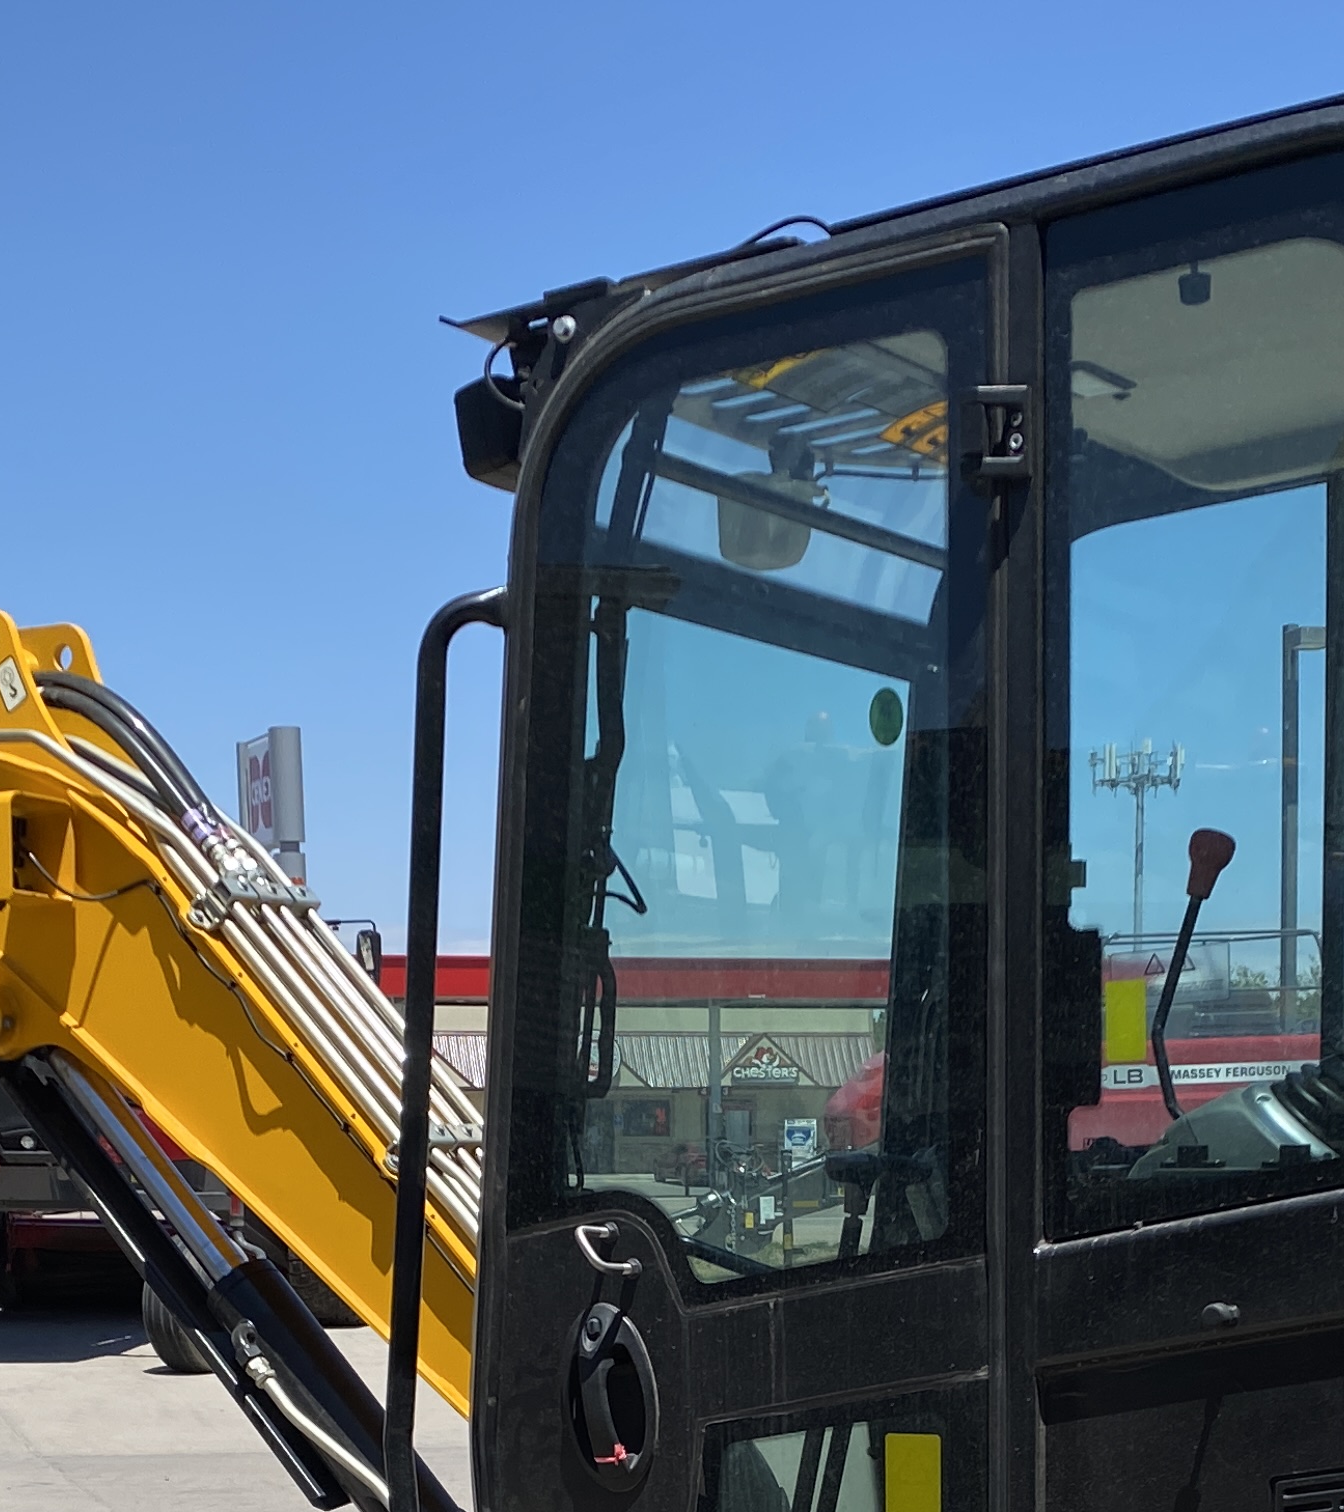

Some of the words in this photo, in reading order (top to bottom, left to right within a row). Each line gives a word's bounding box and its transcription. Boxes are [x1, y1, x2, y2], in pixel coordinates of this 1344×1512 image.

[1113, 1068, 1144, 1085] LB
[1170, 1067, 1221, 1080] MASSEY
[1225, 1064, 1291, 1078] FERGUSON
